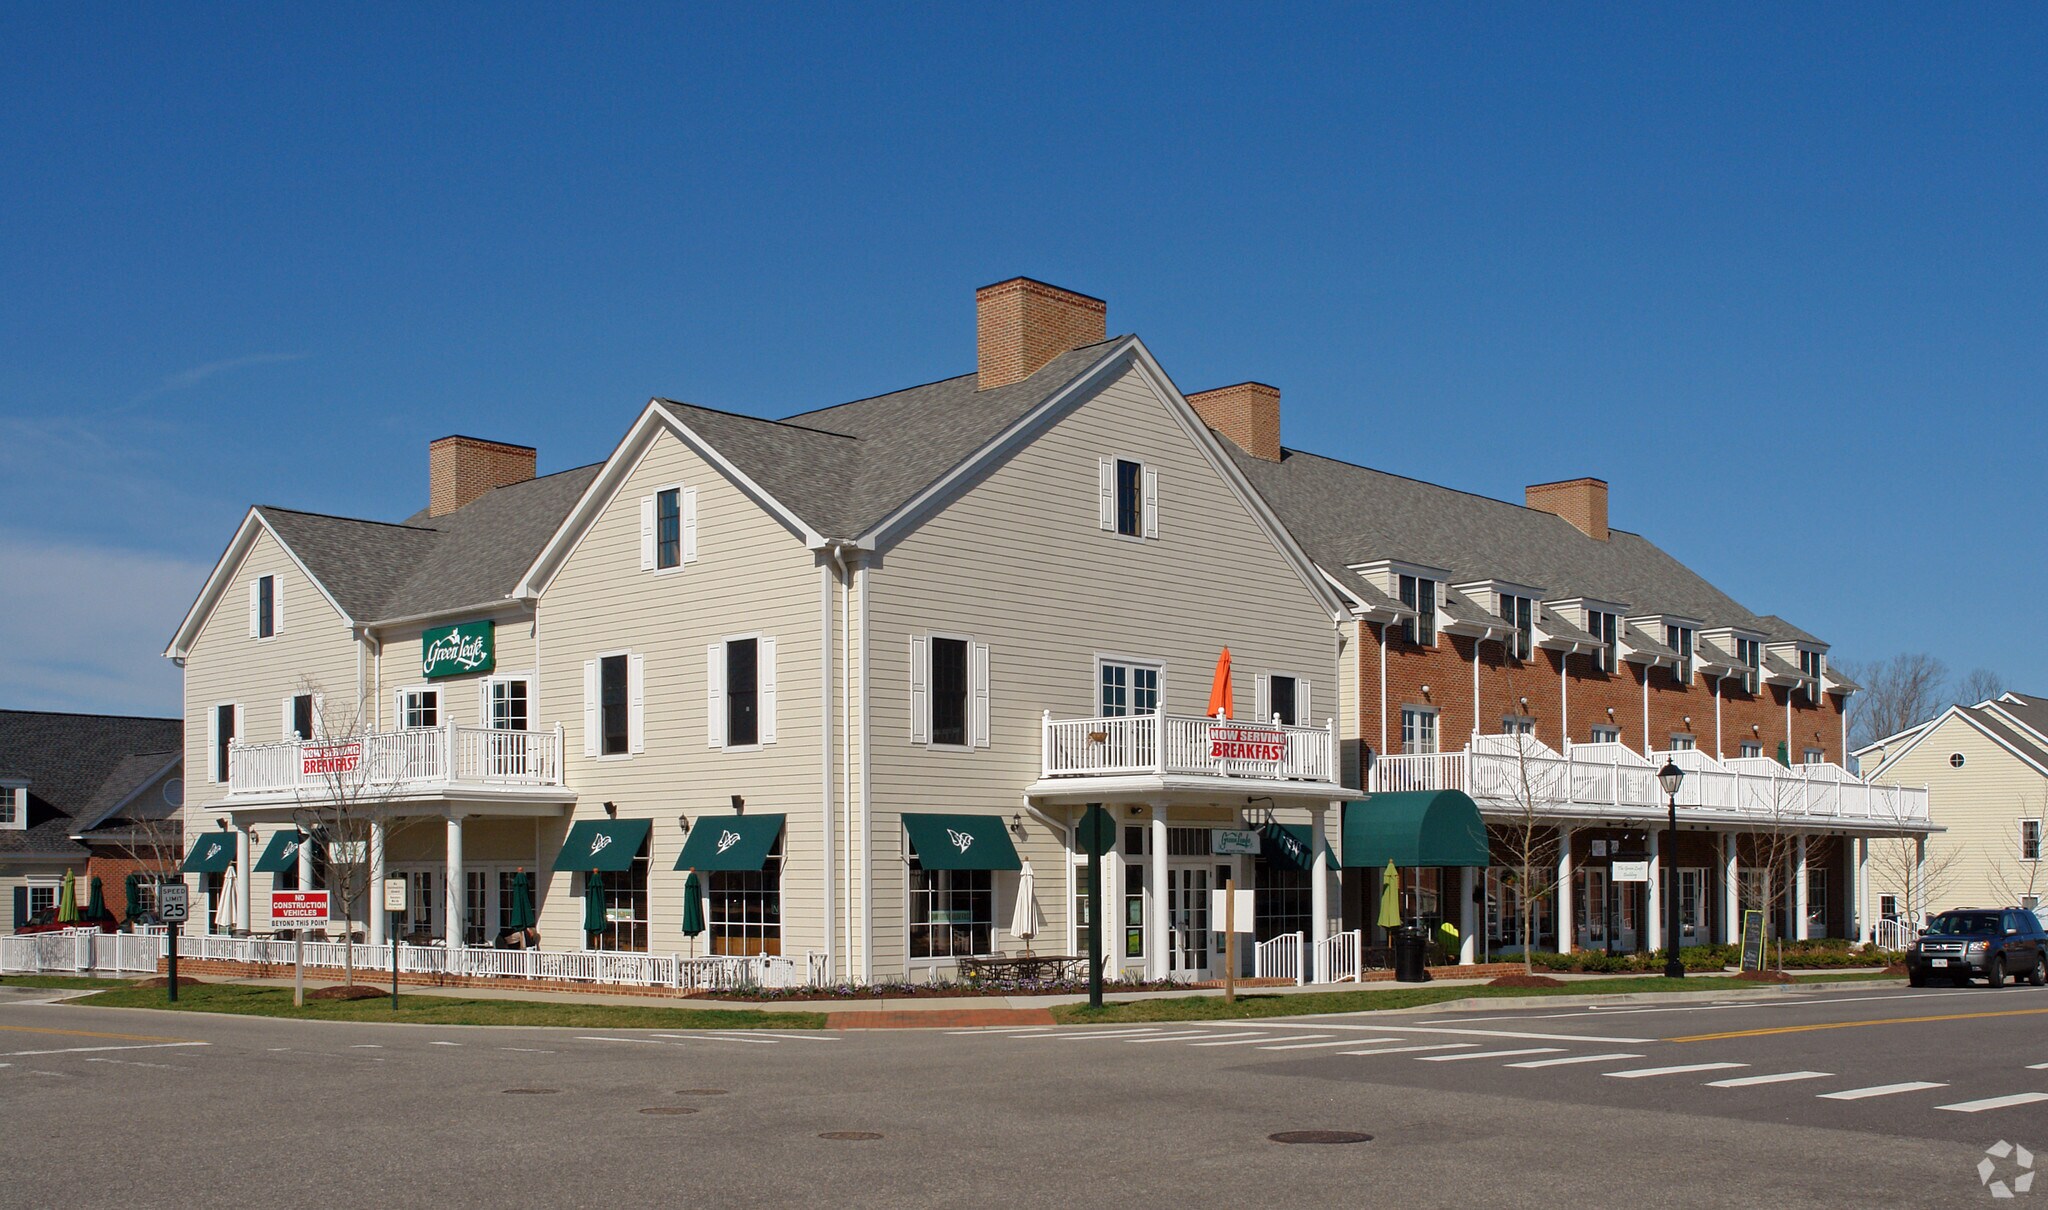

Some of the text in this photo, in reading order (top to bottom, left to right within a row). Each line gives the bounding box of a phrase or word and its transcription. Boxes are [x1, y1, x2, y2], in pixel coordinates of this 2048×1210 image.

[424, 635, 460, 673] Green
[1211, 729, 1285, 744] NOW SERVING
[303, 748, 323, 759] NOW
[1211, 742, 1285, 761] BREAKFAST
[304, 757, 358, 774] BREAKFAST
[164, 904, 185, 917] 25
[283, 909, 317, 917] VEHICLES
[272, 919, 328, 927] BEYOND THIS POINT
